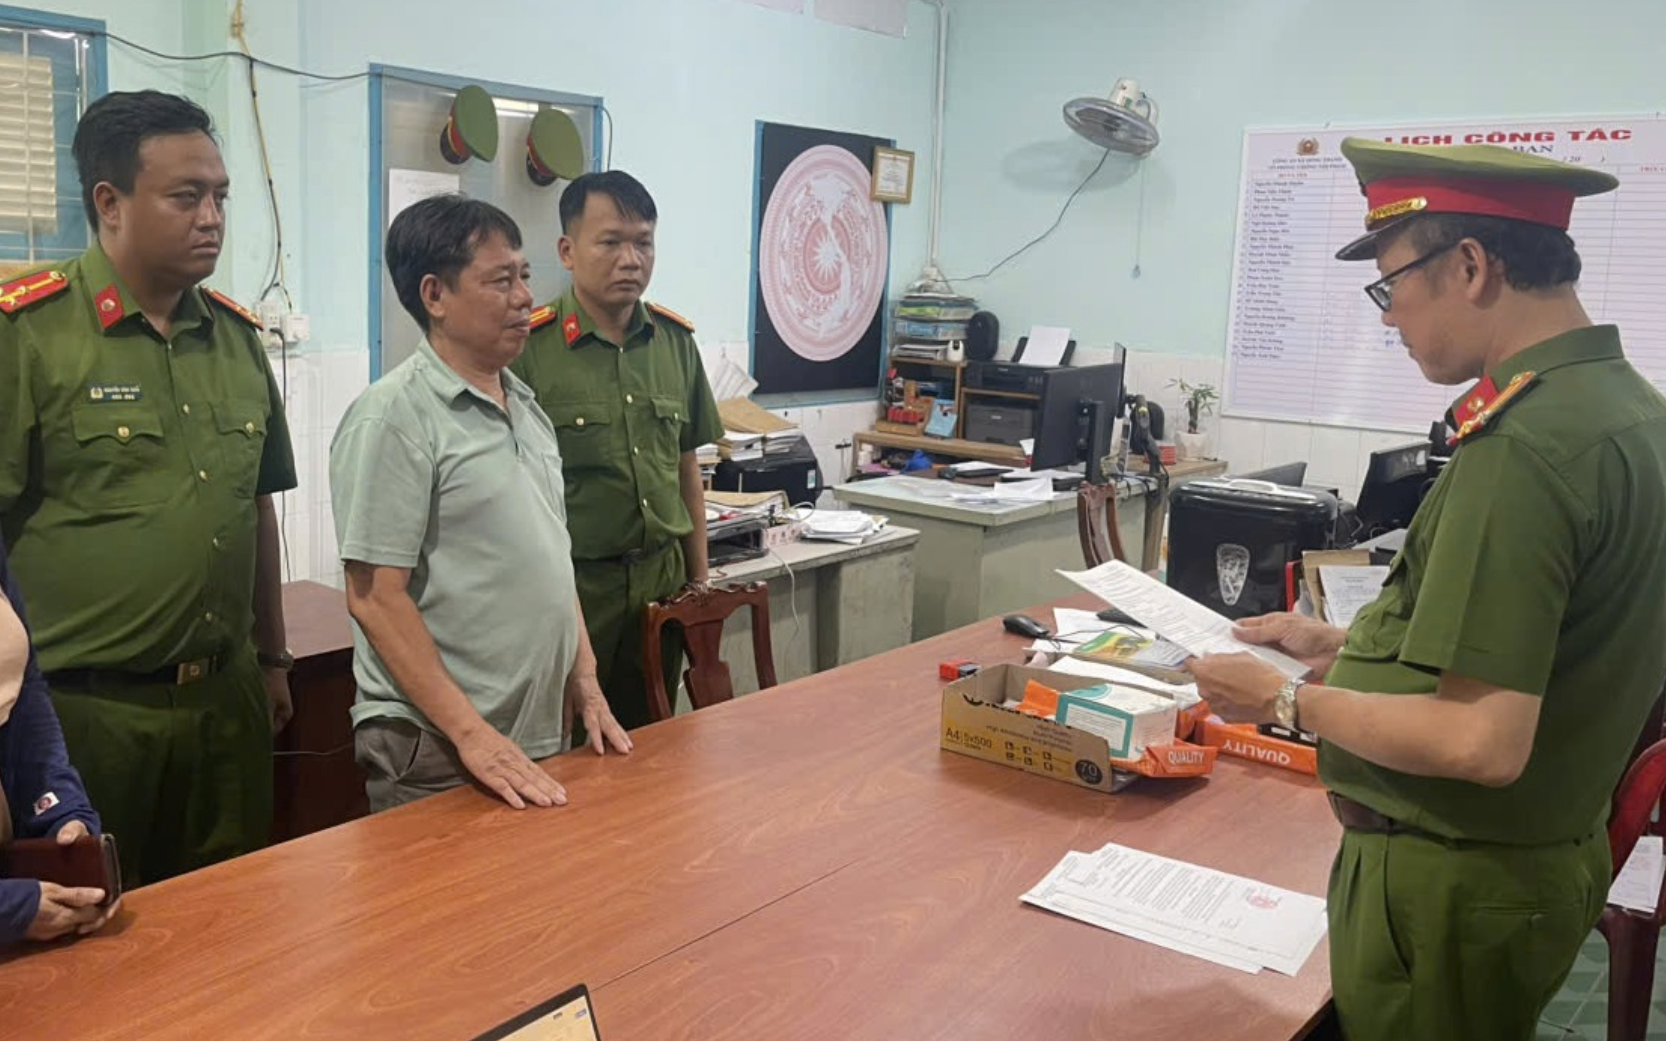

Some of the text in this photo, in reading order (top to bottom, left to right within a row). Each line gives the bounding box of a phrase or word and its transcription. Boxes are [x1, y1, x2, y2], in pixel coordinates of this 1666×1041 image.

[945, 727, 960, 741] A4
[1168, 749, 1205, 766] QUALITY
[1223, 739, 1291, 766] QUALITY
[1079, 761, 1098, 777] 70
